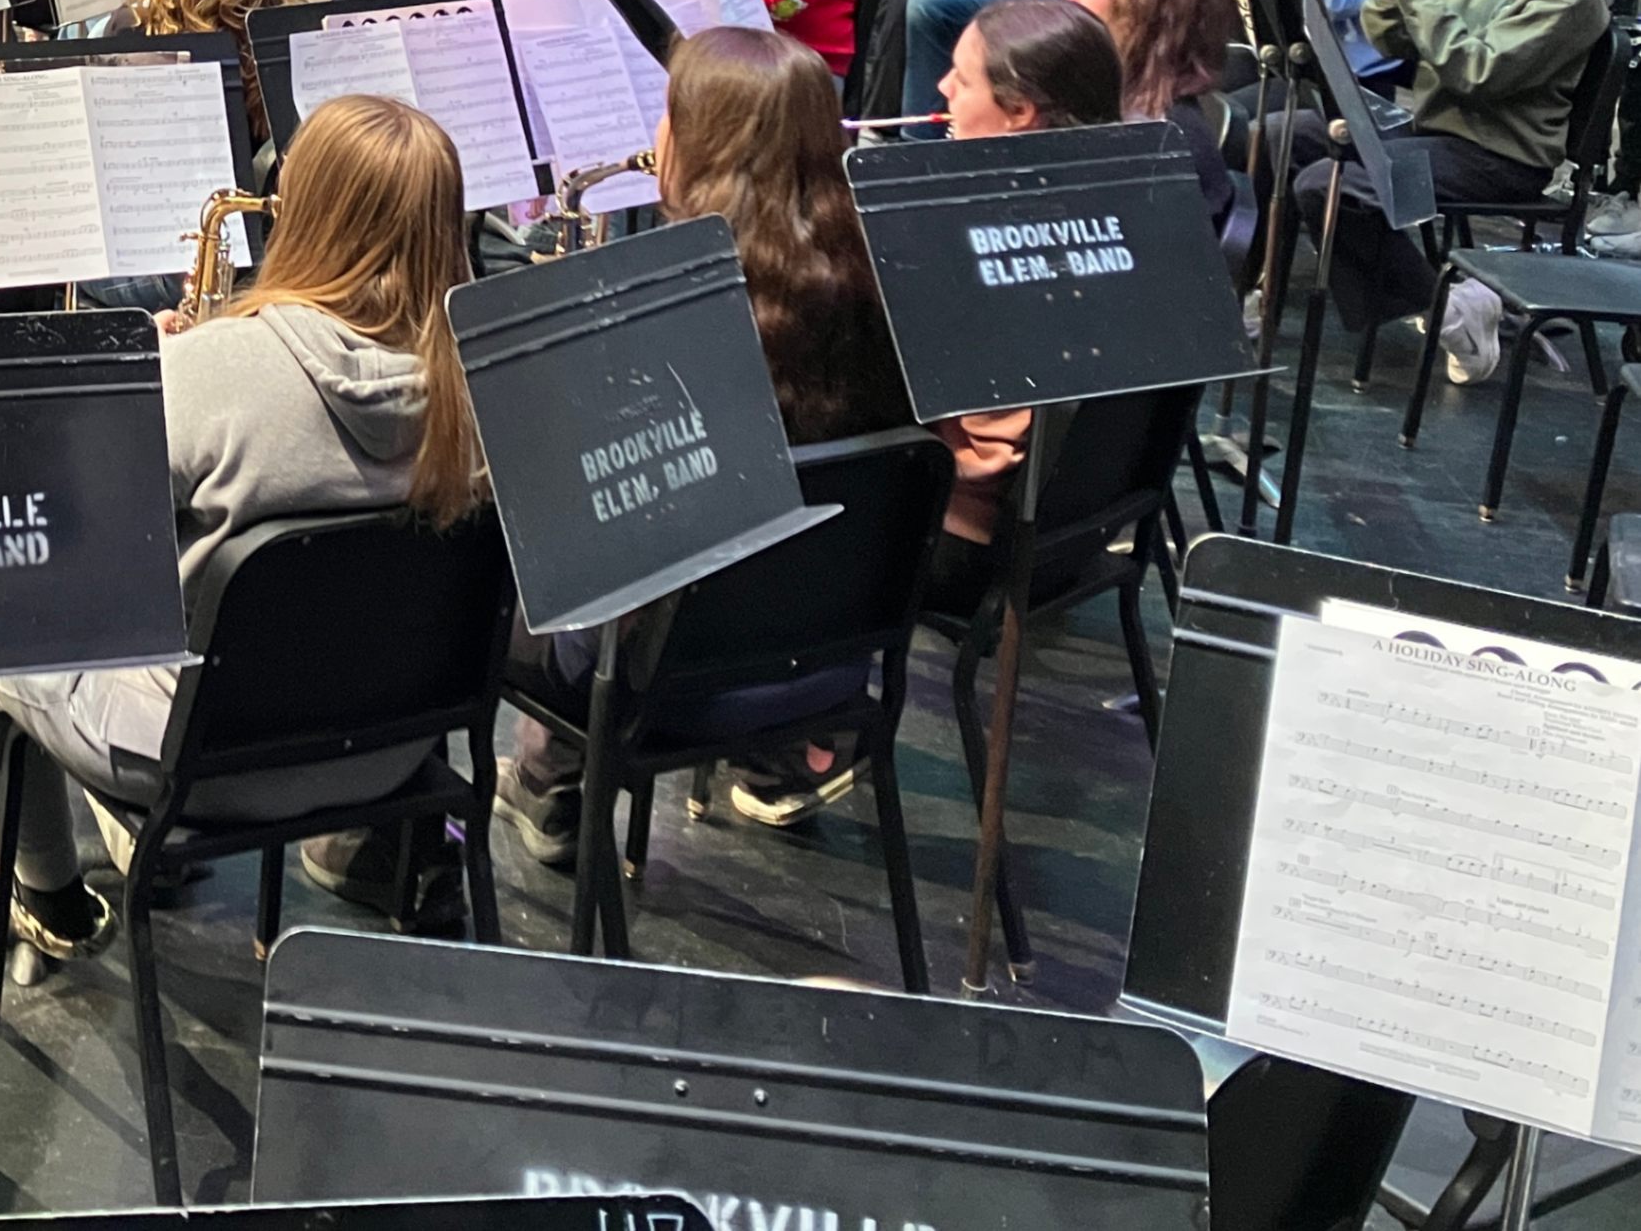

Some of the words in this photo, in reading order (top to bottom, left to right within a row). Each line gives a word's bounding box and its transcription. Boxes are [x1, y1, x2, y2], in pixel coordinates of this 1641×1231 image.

[968, 216, 1124, 255] BROOKVILLE
[978, 255, 1058, 286] ELEM.
[1065, 246, 1135, 277] BAND
[580, 409, 708, 484] BROOKVILLE
[662, 445, 718, 491] BAND
[1372, 639, 1384, 651] A
[1387, 641, 1465, 668] HOLIDAY
[1465, 656, 1577, 693] SING-ALONG
